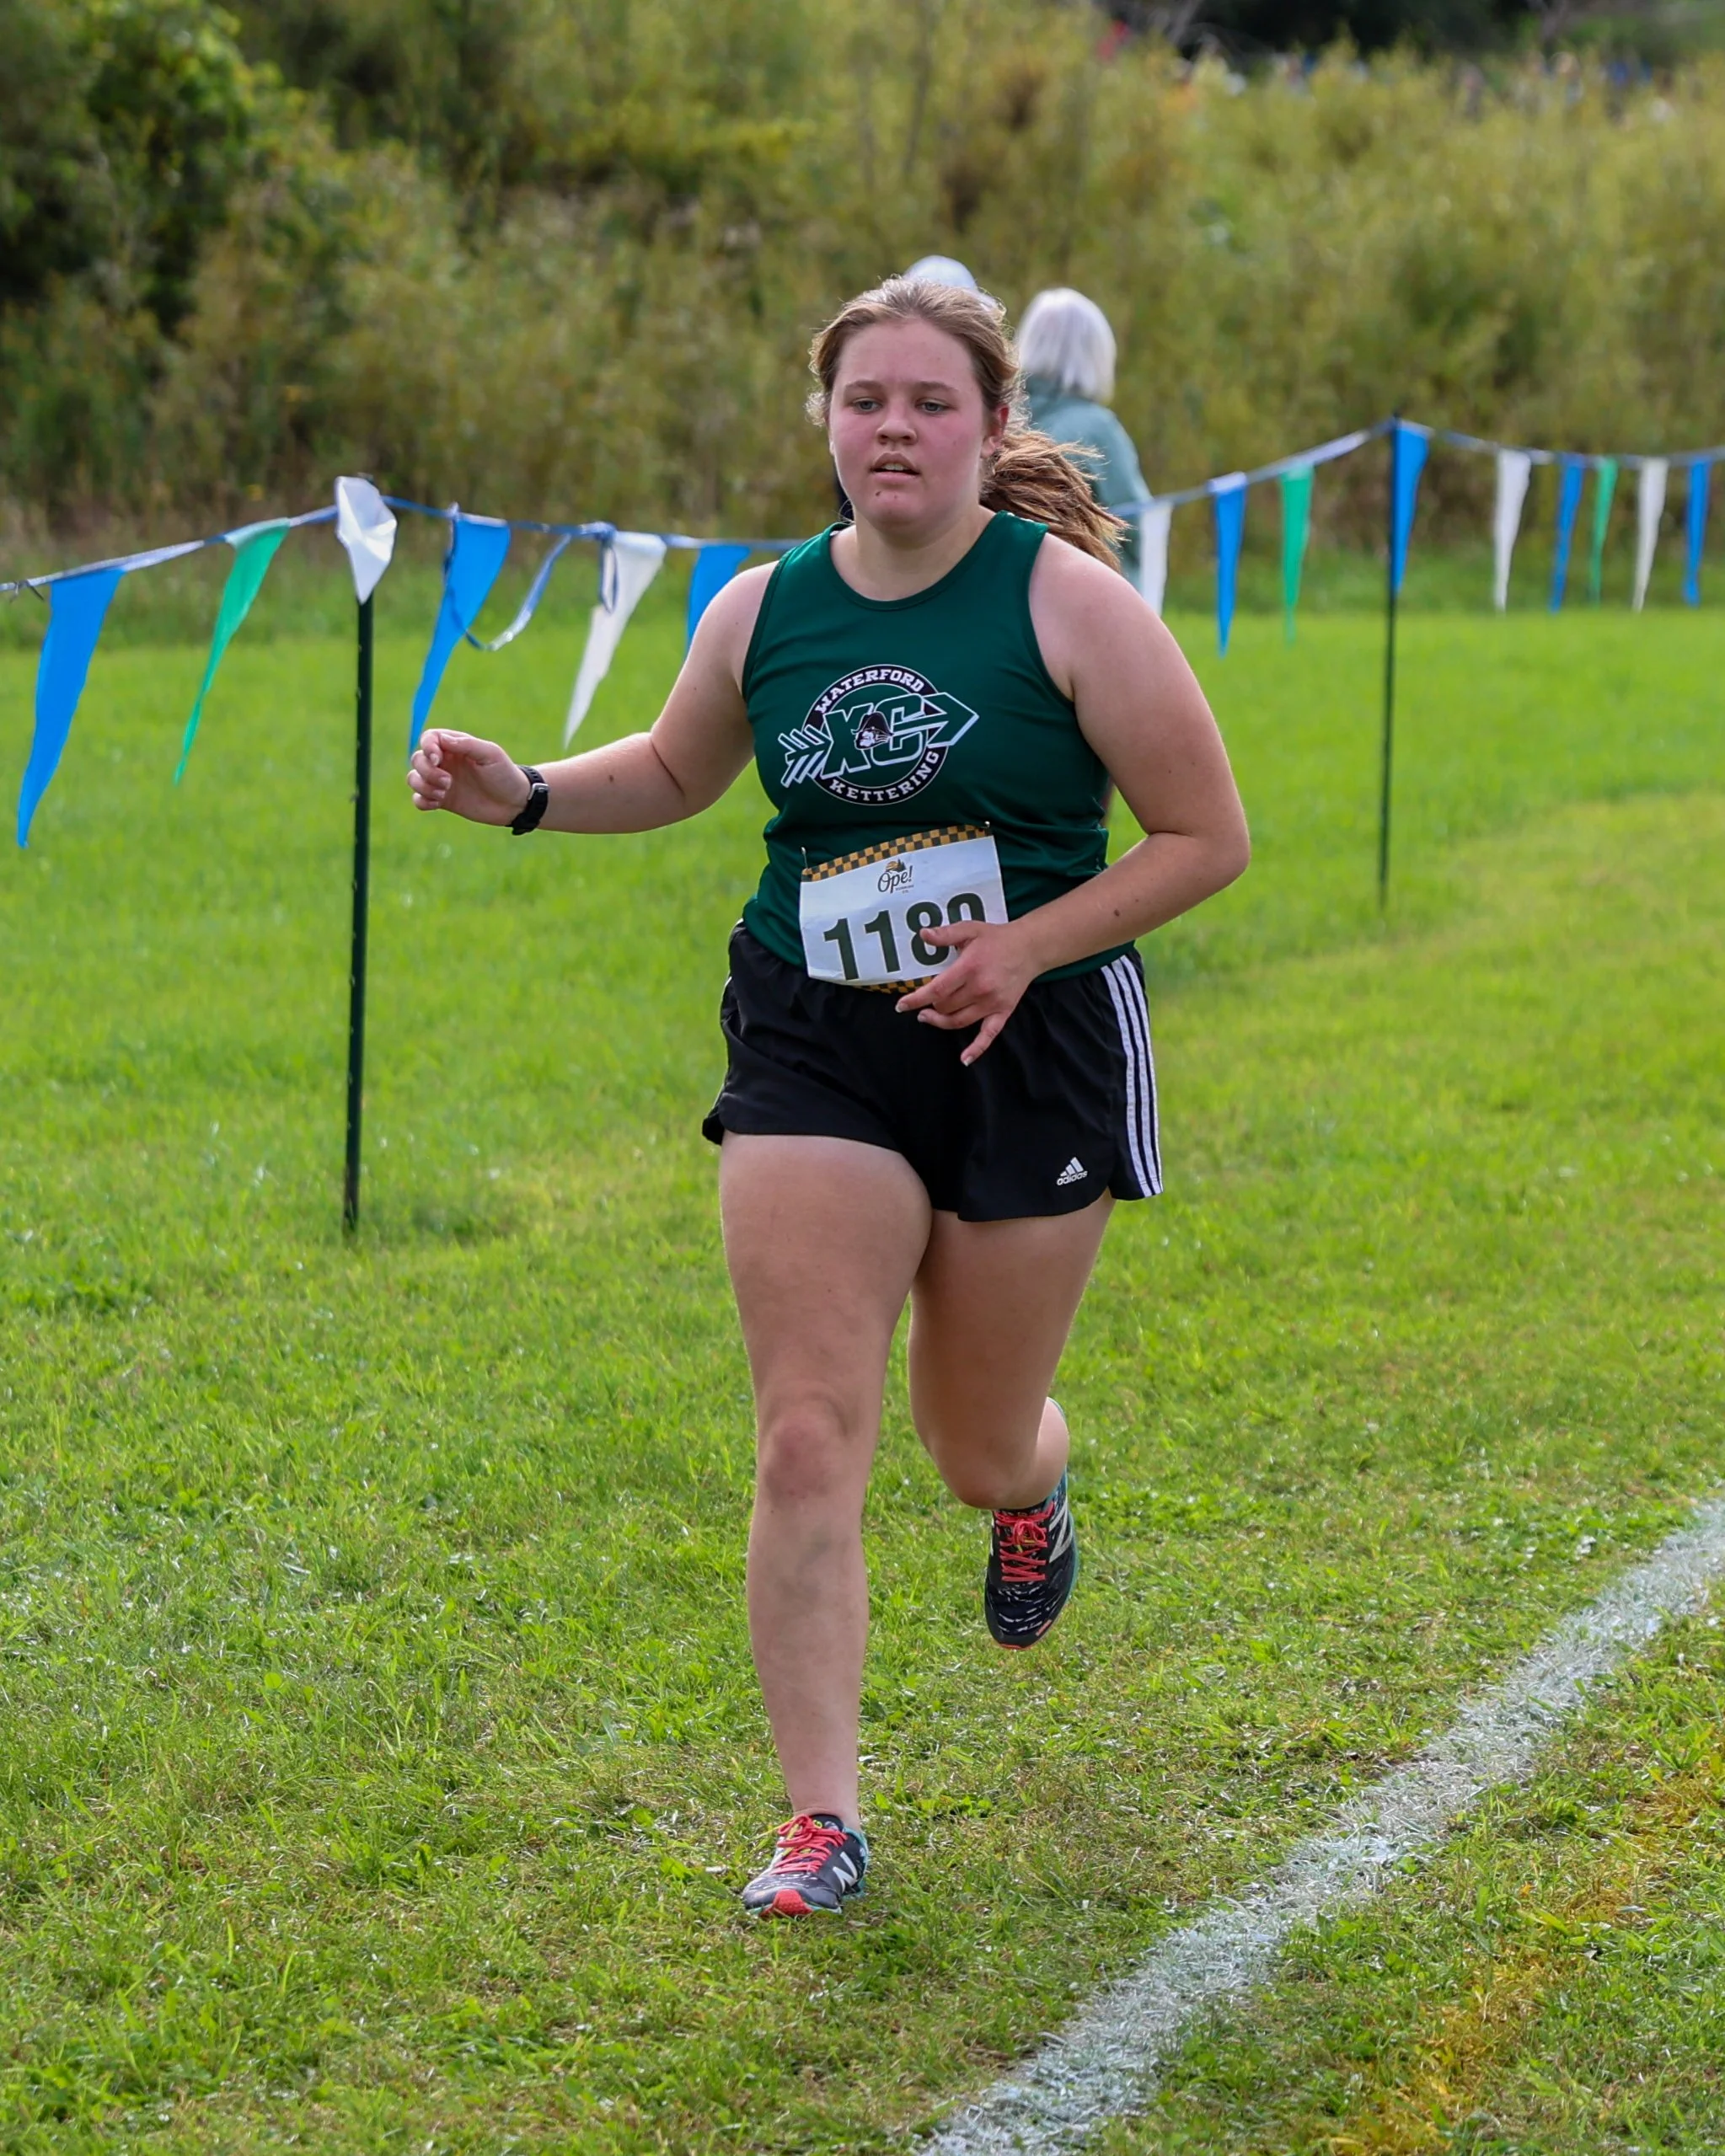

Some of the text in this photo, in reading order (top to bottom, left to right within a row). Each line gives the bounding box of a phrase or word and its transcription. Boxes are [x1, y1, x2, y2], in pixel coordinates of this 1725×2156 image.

[815, 668, 924, 714] WATERFORD
[828, 751, 940, 801] KETTERING
[877, 865, 913, 894] Ope!
[1057, 1170, 1088, 1185] adidas
